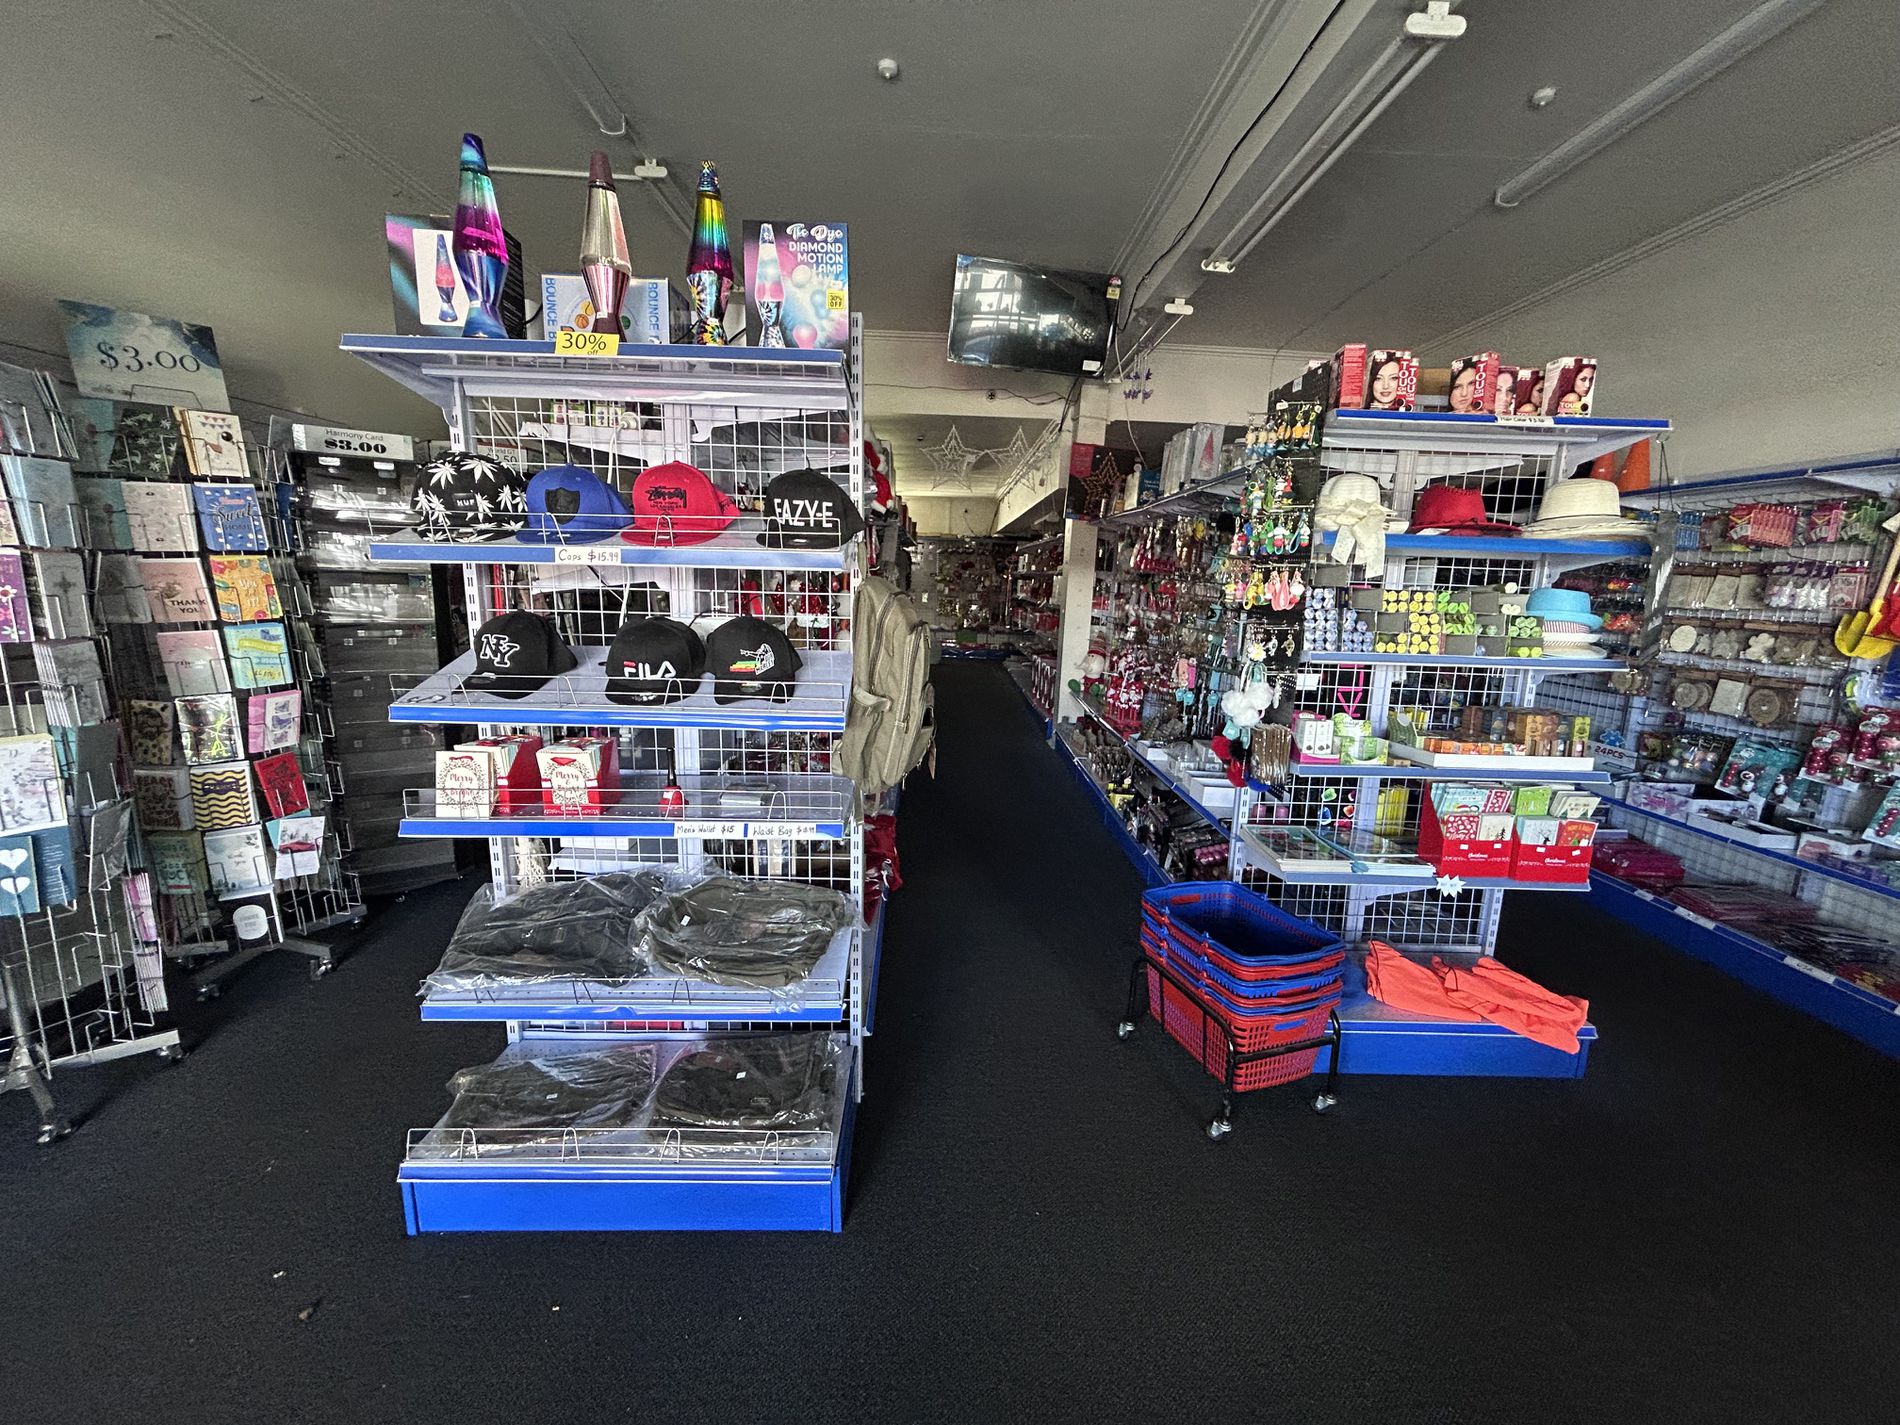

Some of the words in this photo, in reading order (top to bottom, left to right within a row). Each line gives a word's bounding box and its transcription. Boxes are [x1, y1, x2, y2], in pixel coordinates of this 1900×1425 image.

[788, 241, 843, 253] DIAMOND
[797, 252, 843, 263] MOTION
[812, 264, 843, 274] LAMP
[545, 277, 558, 327] BOUNCE
[647, 282, 659, 331] BOUNCE
[561, 332, 607, 351] 30%
[96, 340, 200, 373] $3.00
[587, 348, 599, 356] off
[325, 429, 364, 440] Harmony
[365, 433, 384, 441] Card
[324, 438, 387, 454] $3.00
[774, 498, 833, 528] EAZY-E
[559, 549, 581, 561] Caps
[588, 549, 619, 562] $15.99
[624, 660, 676, 680] FILA
[1595, 745, 1624, 760] 24PCS
[450, 773, 473, 784] Merry
[555, 771, 579, 782] Merry
[721, 825, 735, 833] $15
[753, 825, 775, 836] Waist
[779, 826, 793, 837] Bag
